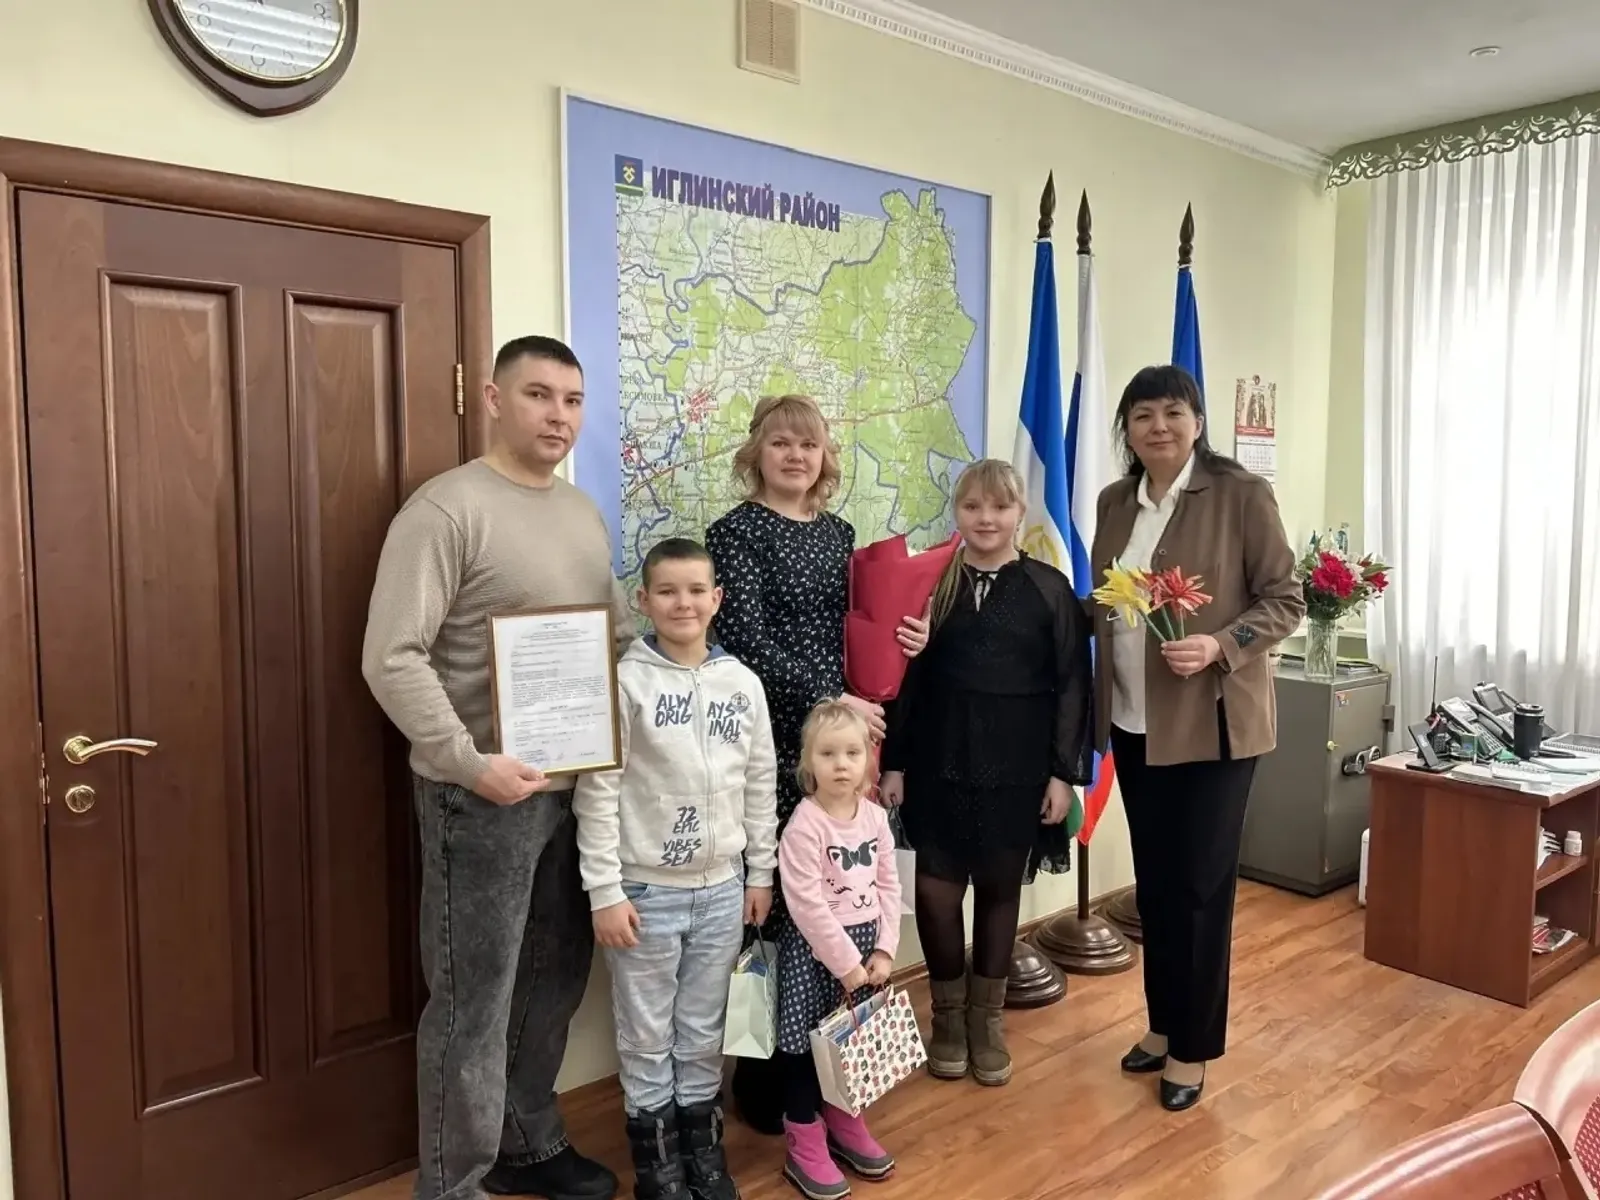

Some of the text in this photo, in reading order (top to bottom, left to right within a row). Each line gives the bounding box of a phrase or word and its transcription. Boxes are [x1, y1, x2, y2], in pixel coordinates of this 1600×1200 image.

[652, 166, 841, 233] ИГЛИНСКИЙ РАЙОН
[656, 690, 693, 711] ALW
[707, 701, 736, 718] AYS
[655, 709, 693, 728] ORIG
[708, 717, 741, 738] INAL
[677, 806, 697, 823] 72
[663, 838, 702, 853] VIBES
[657, 850, 694, 867] SEA
